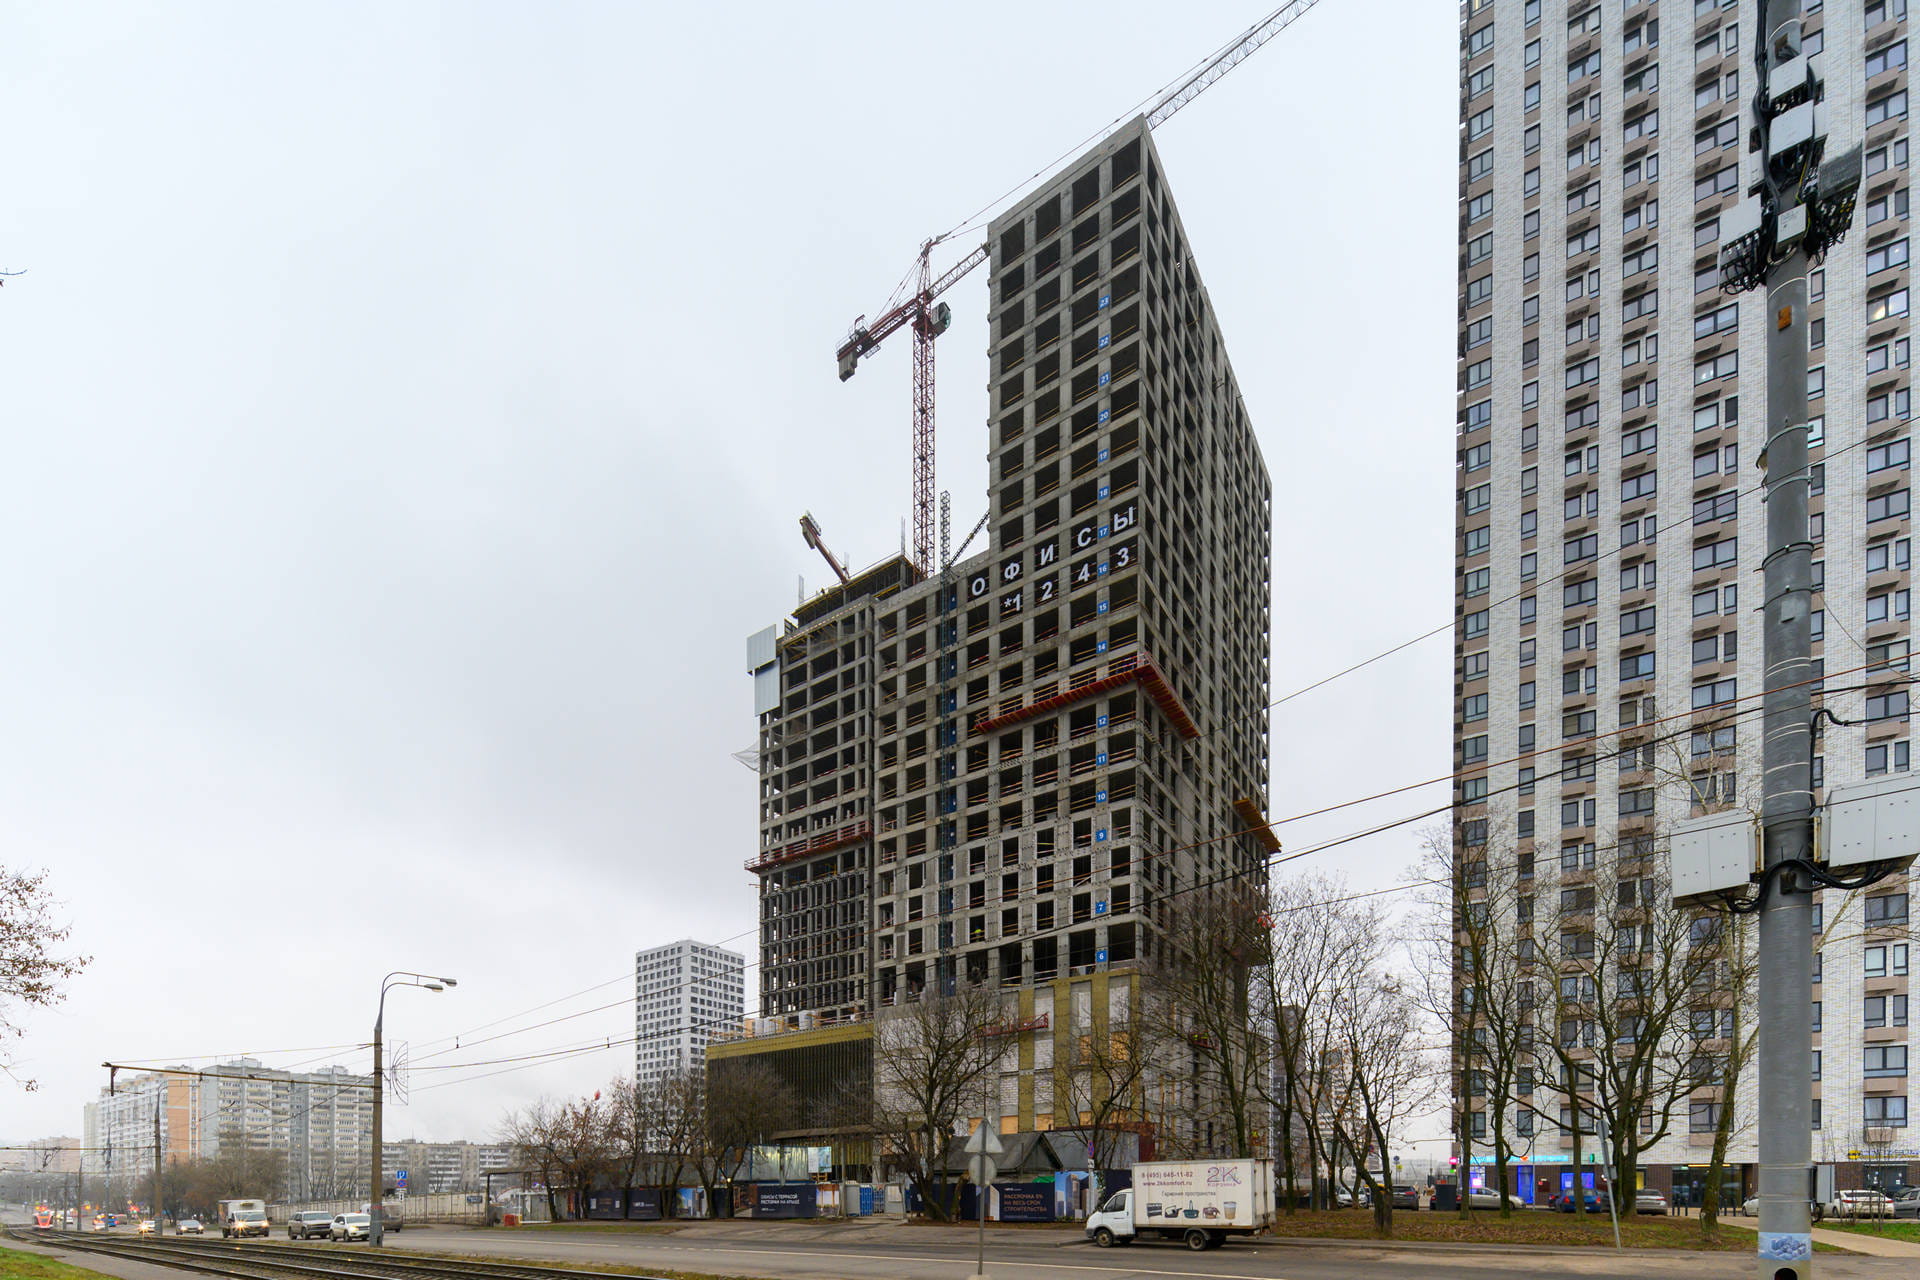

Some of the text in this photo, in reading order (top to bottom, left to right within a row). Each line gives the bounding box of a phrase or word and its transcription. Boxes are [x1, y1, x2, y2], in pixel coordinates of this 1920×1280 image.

[1100, 297, 1109, 307] 23
[1100, 336, 1109, 346] 22
[1100, 374, 1109, 383] 21
[1099, 411, 1109, 421] 20
[1099, 451, 1107, 460] 19
[1100, 488, 1108, 497] 18
[1100, 527, 1108, 536] 17
[972, 506, 1134, 596] ОФИСЫ
[1099, 565, 1107, 574] 16
[1099, 603, 1107, 612] 15
[1098, 717, 1106, 725] 12
[1098, 793, 1106, 801] 10
